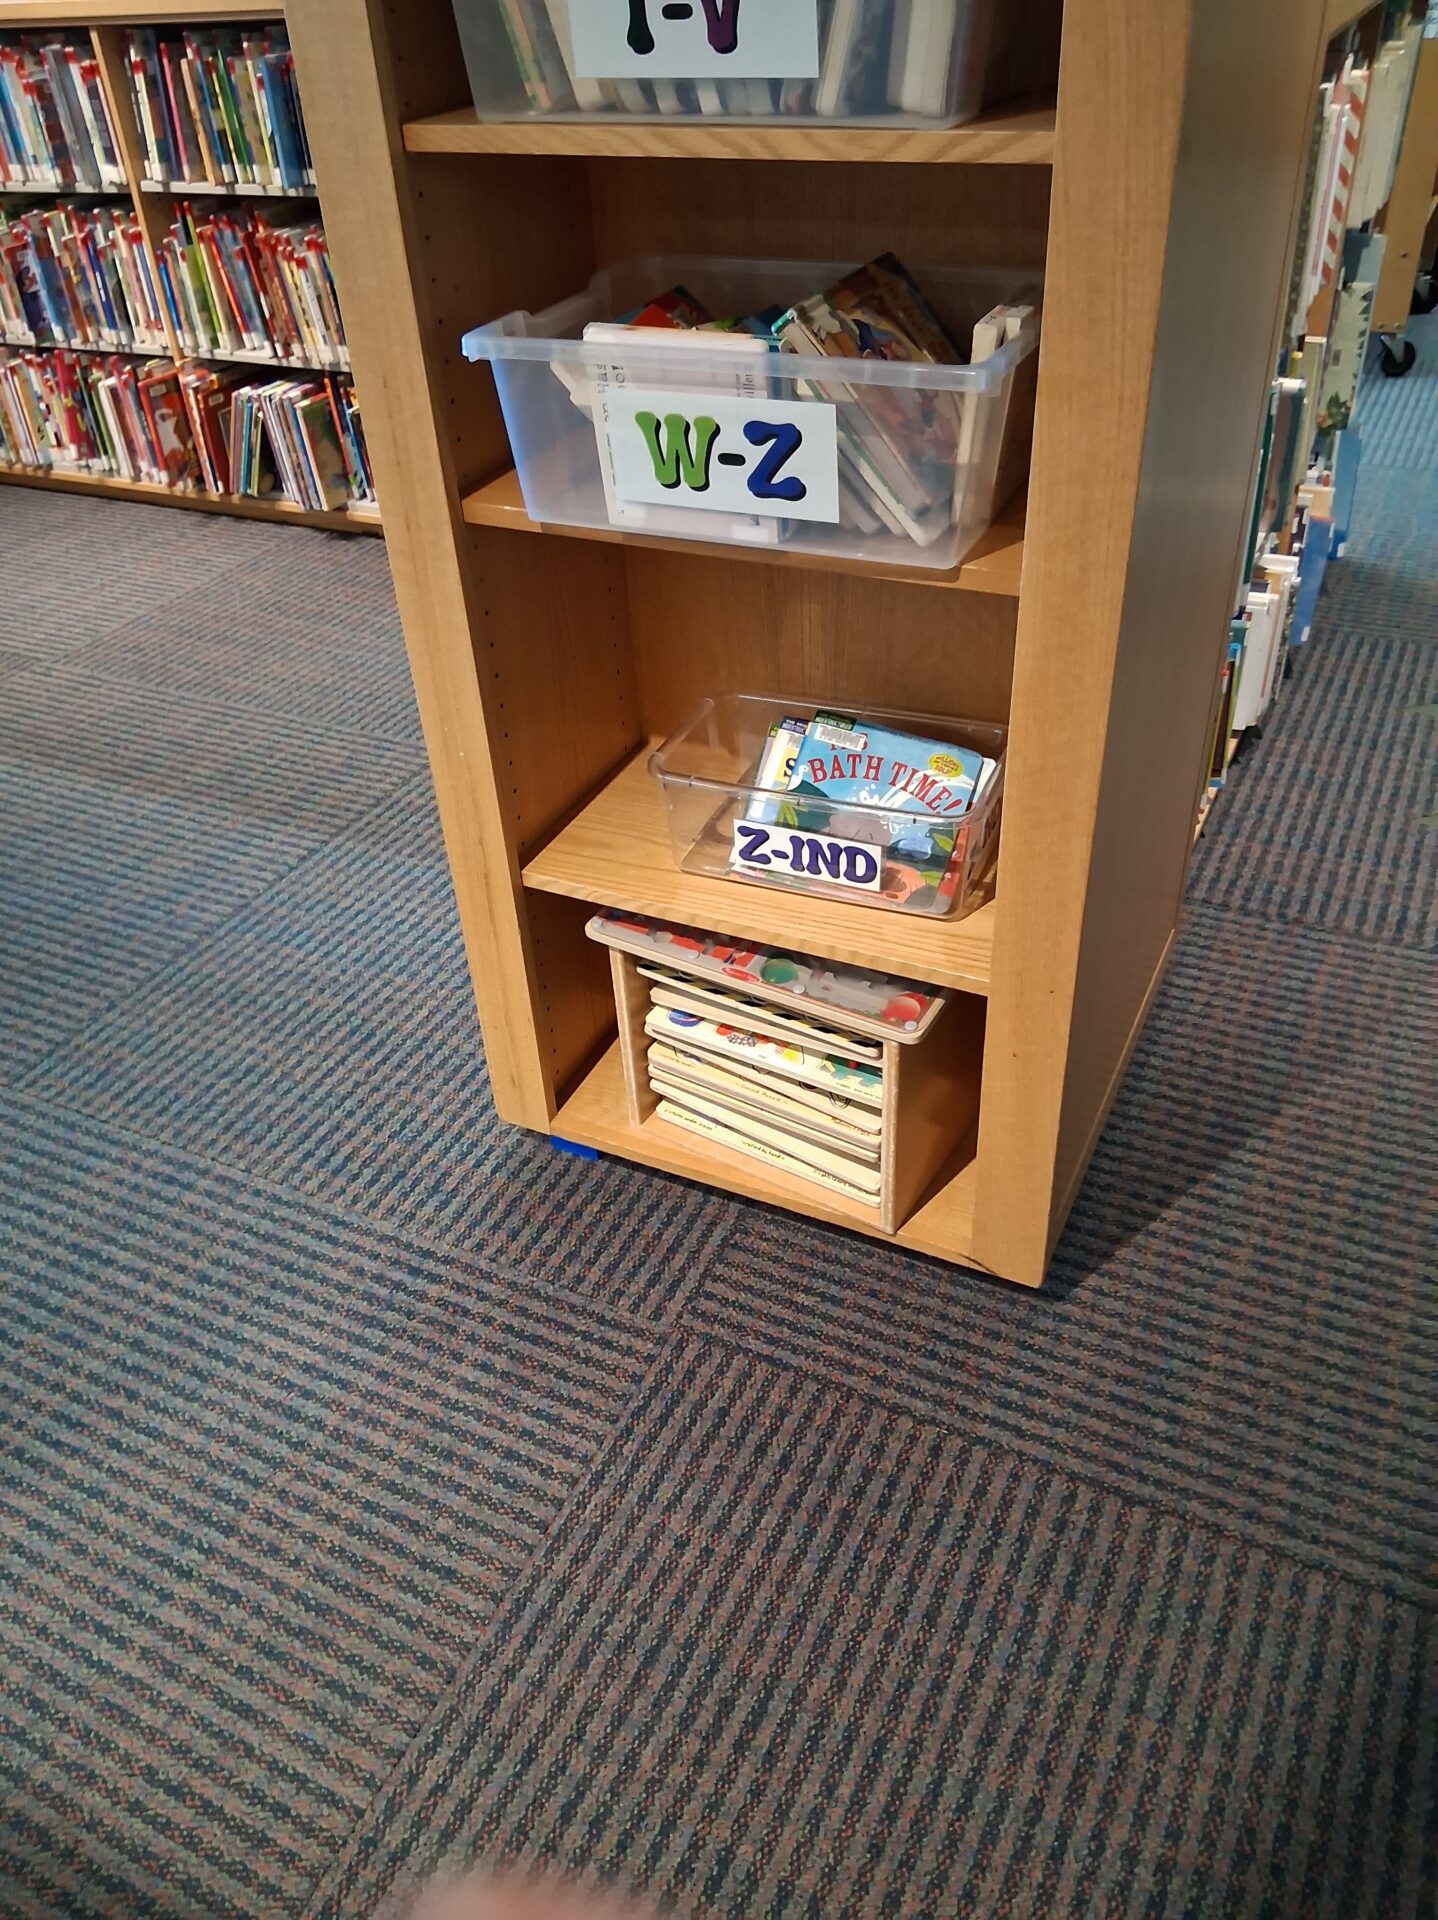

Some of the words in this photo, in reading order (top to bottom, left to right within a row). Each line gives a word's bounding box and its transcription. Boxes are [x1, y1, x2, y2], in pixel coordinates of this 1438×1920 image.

[634, 411, 808, 502] W-Z
[807, 753, 884, 784] BATH
[888, 761, 963, 814] TIME!
[737, 825, 878, 884] Z-IND
